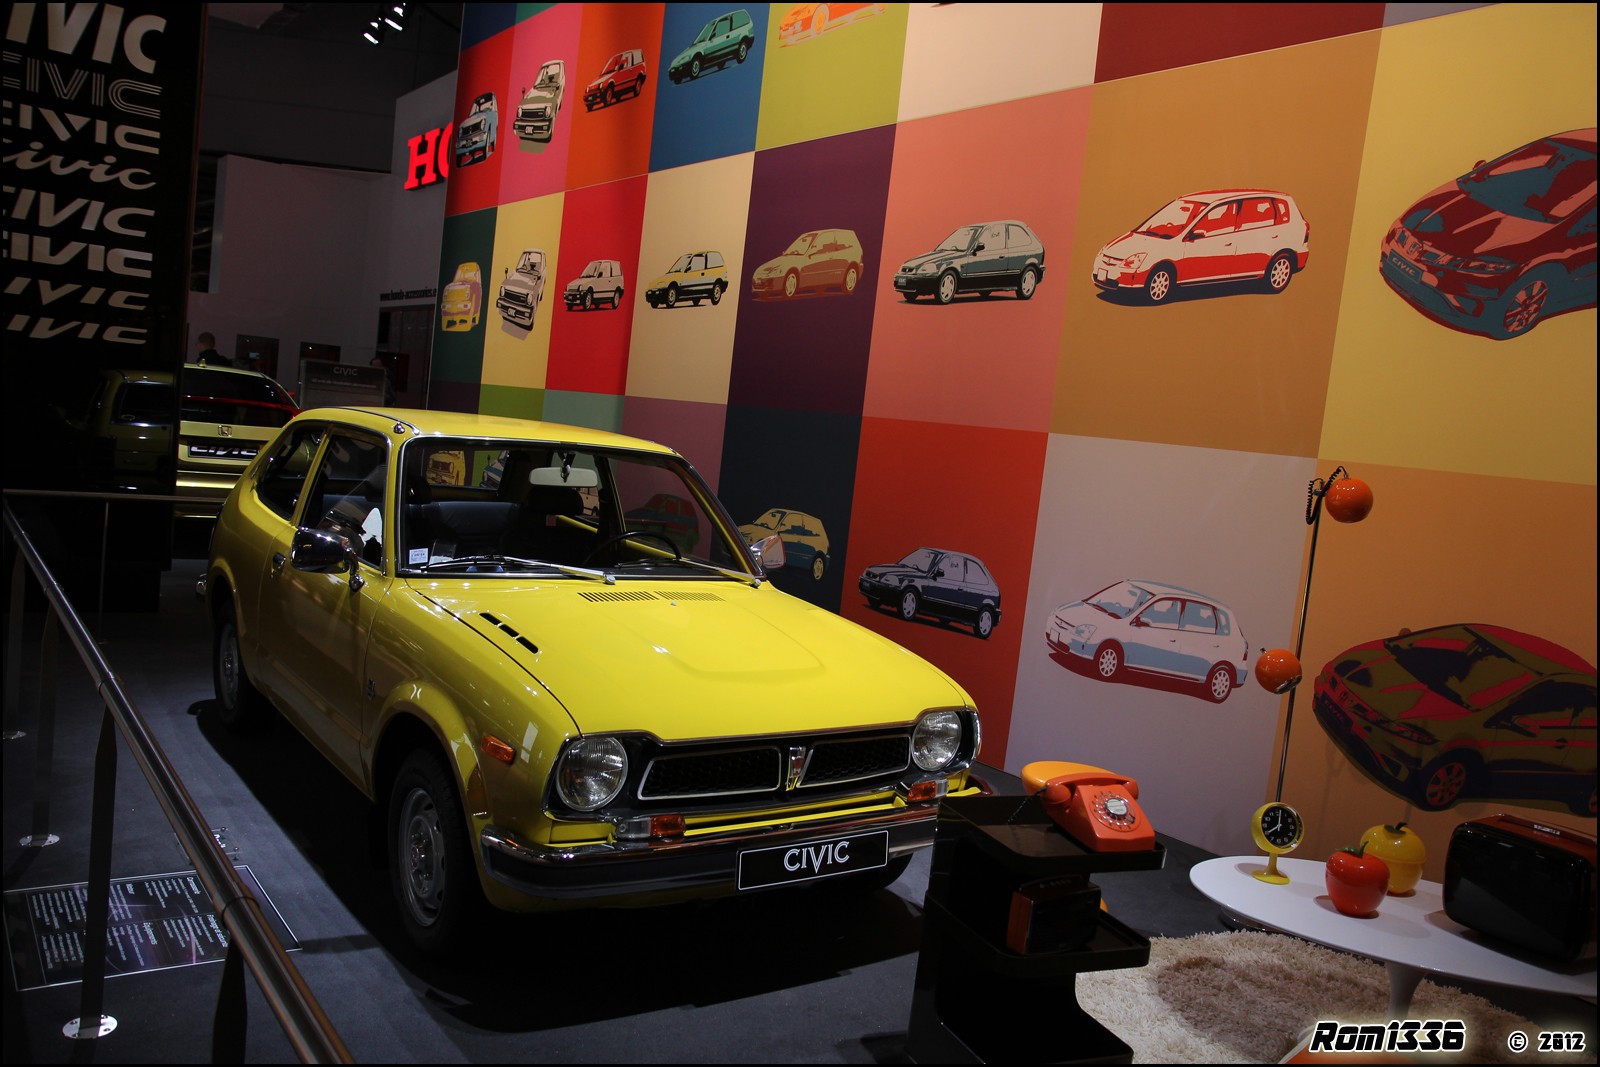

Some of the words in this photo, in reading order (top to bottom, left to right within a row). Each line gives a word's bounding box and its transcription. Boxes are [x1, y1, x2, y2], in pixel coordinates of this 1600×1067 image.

[3, 100, 161, 155] IVIC
[3, 185, 156, 238] IVIC
[3, 230, 153, 279] IVIC
[1392, 257, 1416, 276] CIVIC
[333, 366, 359, 377] CIVIC
[190, 445, 258, 456] CIVIC
[783, 841, 850, 875] CIVIC
